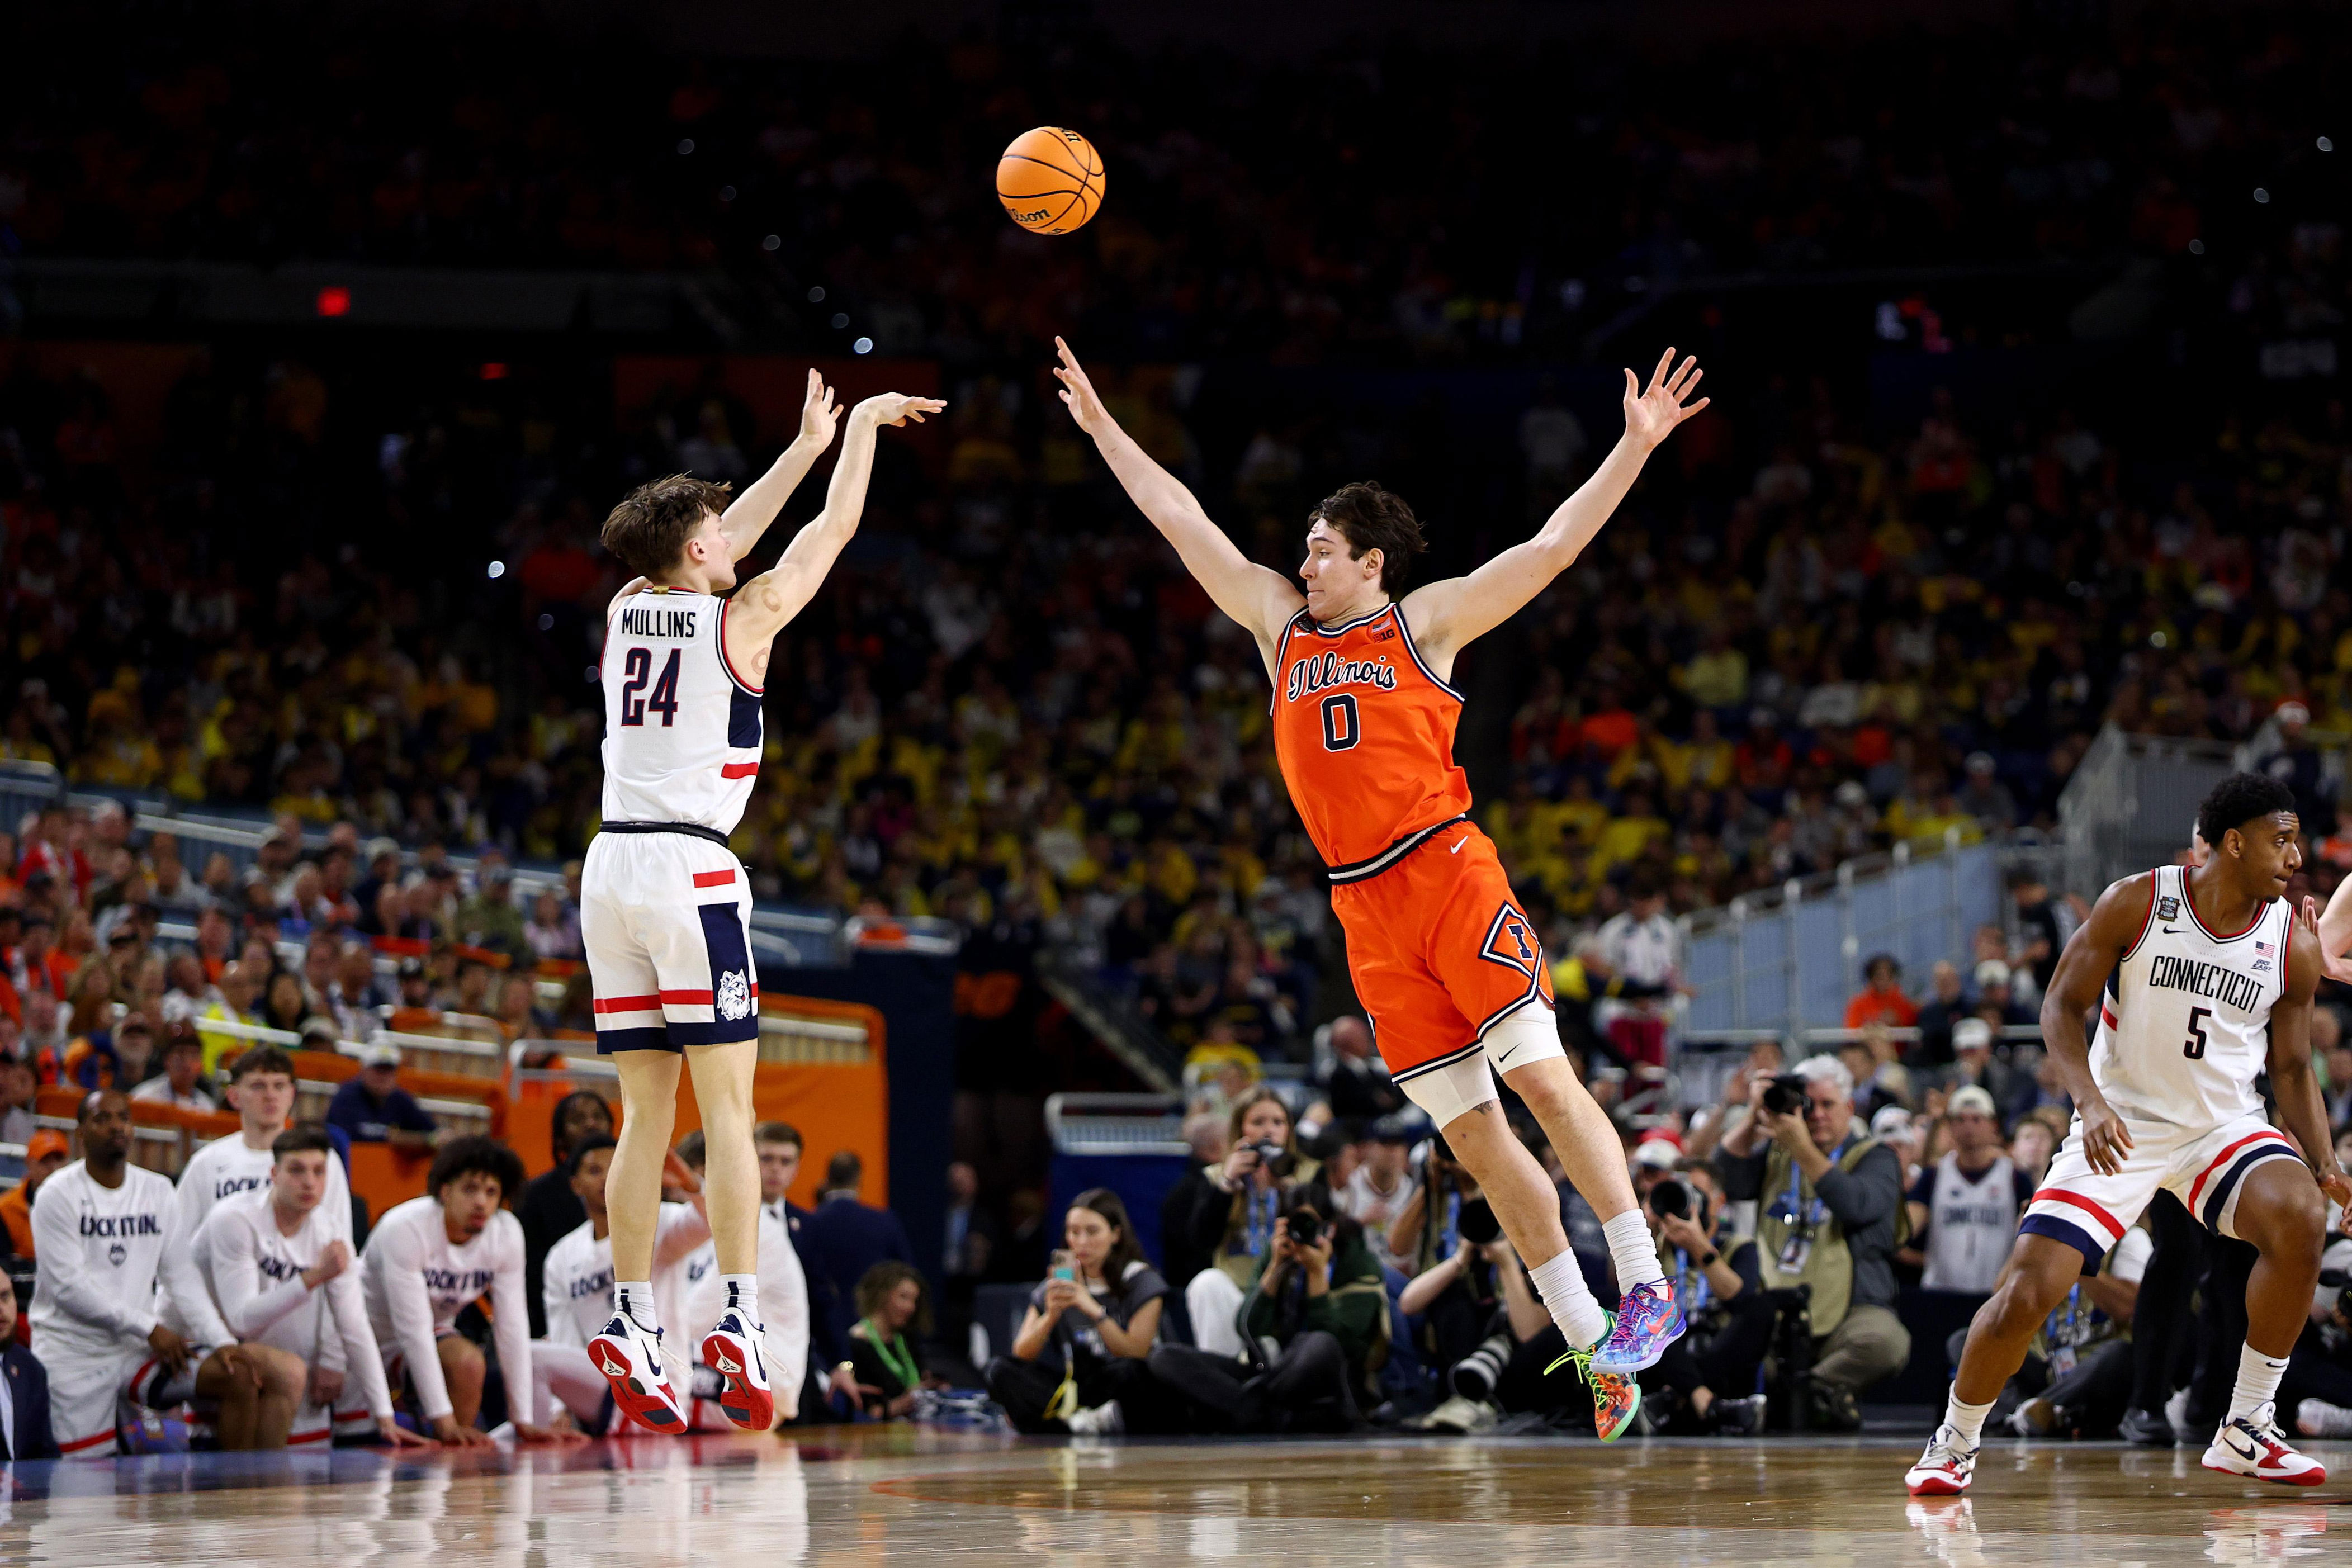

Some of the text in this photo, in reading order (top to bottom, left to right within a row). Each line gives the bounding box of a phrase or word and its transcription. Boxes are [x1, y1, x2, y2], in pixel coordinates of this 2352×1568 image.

[622, 608, 697, 638] MULLINS
[621, 647, 682, 727] 24
[1287, 651, 1397, 702] Illinois
[1319, 693, 1360, 752] 0
[2149, 955, 2264, 1014] CONNECTICUT
[2183, 1006, 2212, 1060] 5
